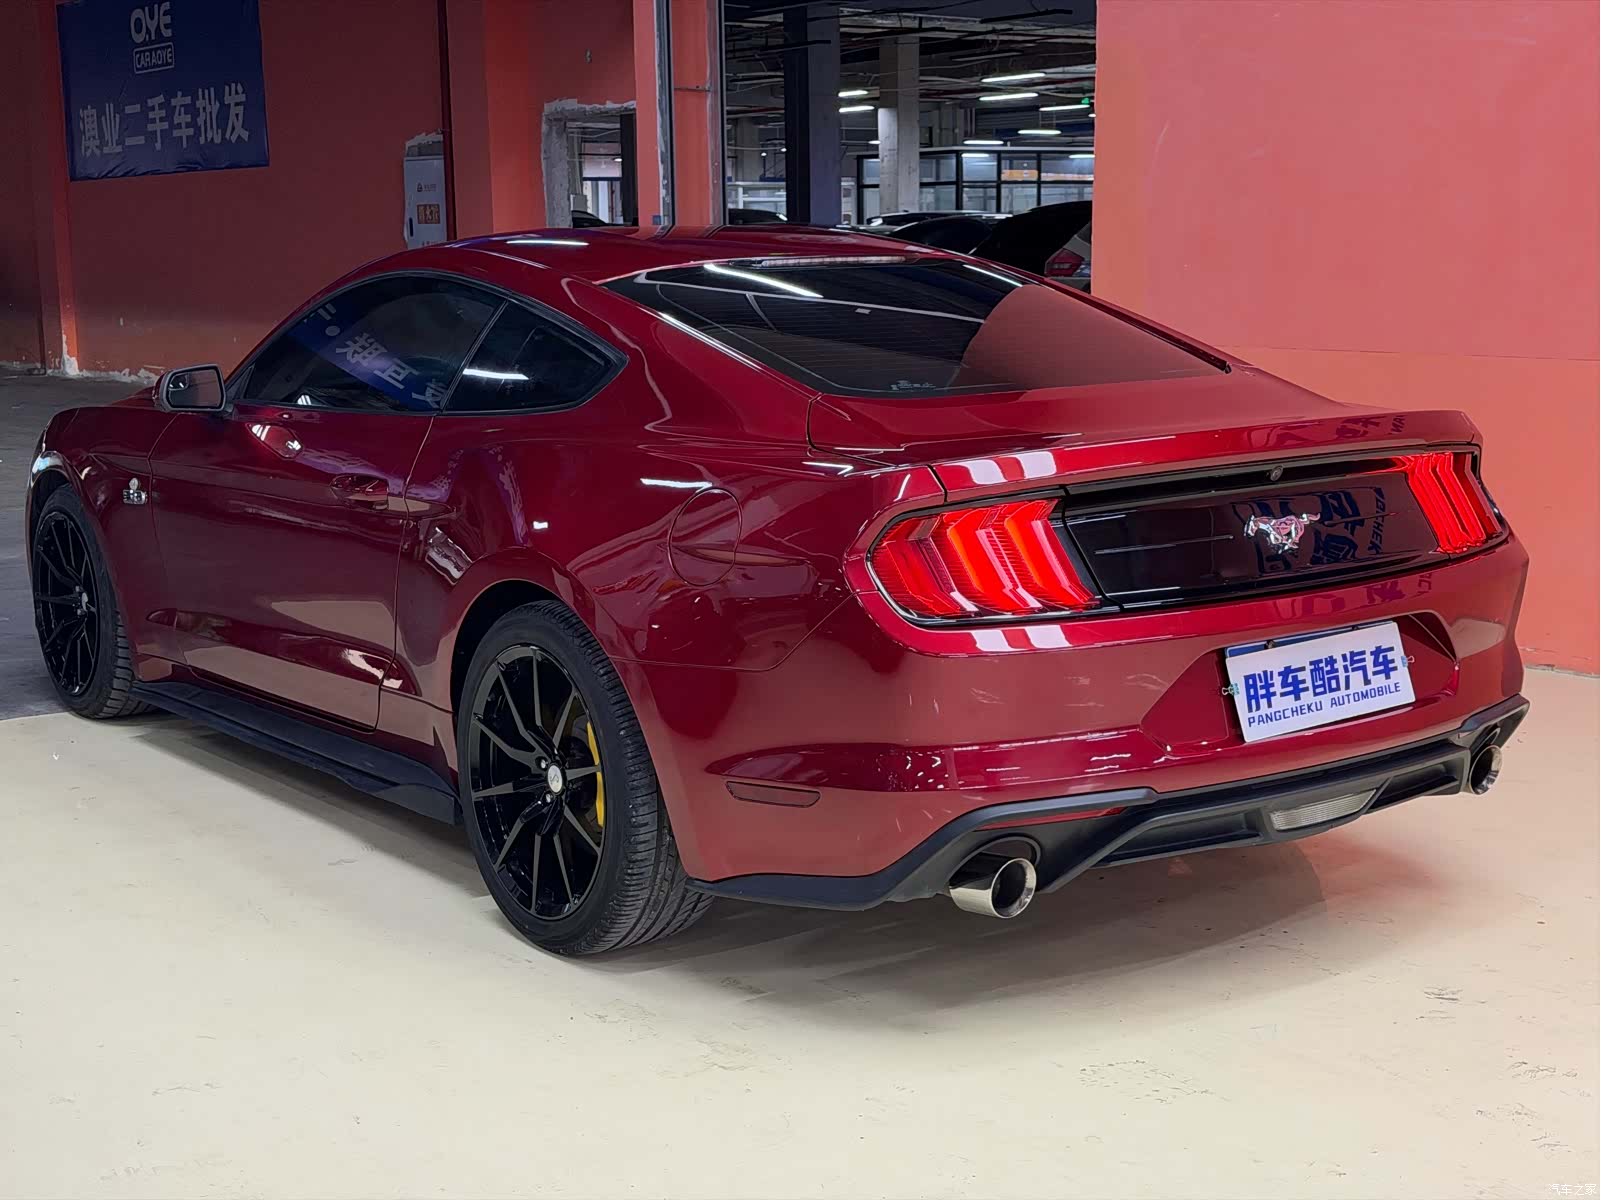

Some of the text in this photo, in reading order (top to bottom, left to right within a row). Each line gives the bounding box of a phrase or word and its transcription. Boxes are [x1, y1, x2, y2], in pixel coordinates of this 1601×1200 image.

[79, 82, 249, 157] 澳业二手车批发
[1243, 645, 1398, 713] 胖车酷汽车
[1248, 682, 1401, 728] PANGCHEKU AUTOMOBILE
